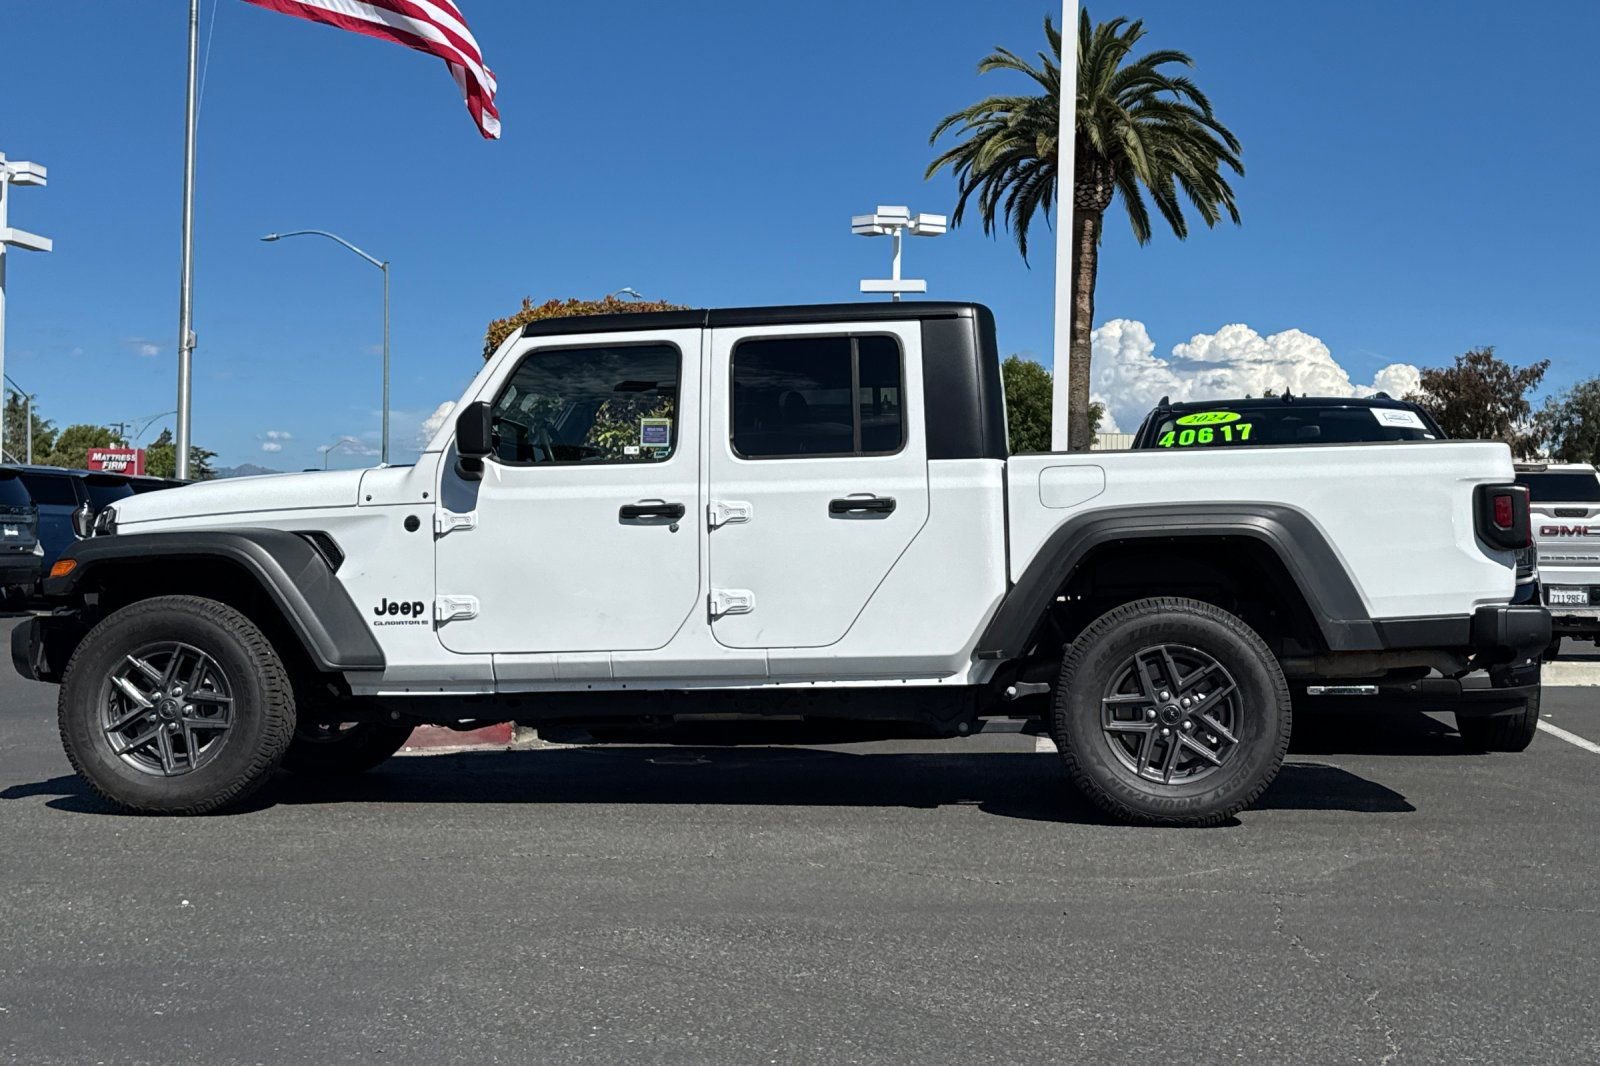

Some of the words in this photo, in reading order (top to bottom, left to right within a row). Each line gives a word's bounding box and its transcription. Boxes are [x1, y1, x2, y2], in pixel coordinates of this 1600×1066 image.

[1186, 413, 1229, 423] 2024
[1159, 423, 1252, 447] 40617
[92, 453, 136, 461] MATTRESS
[102, 461, 127, 470] FIRM
[1540, 526, 1600, 537] GMC
[374, 597, 425, 618] Jeep
